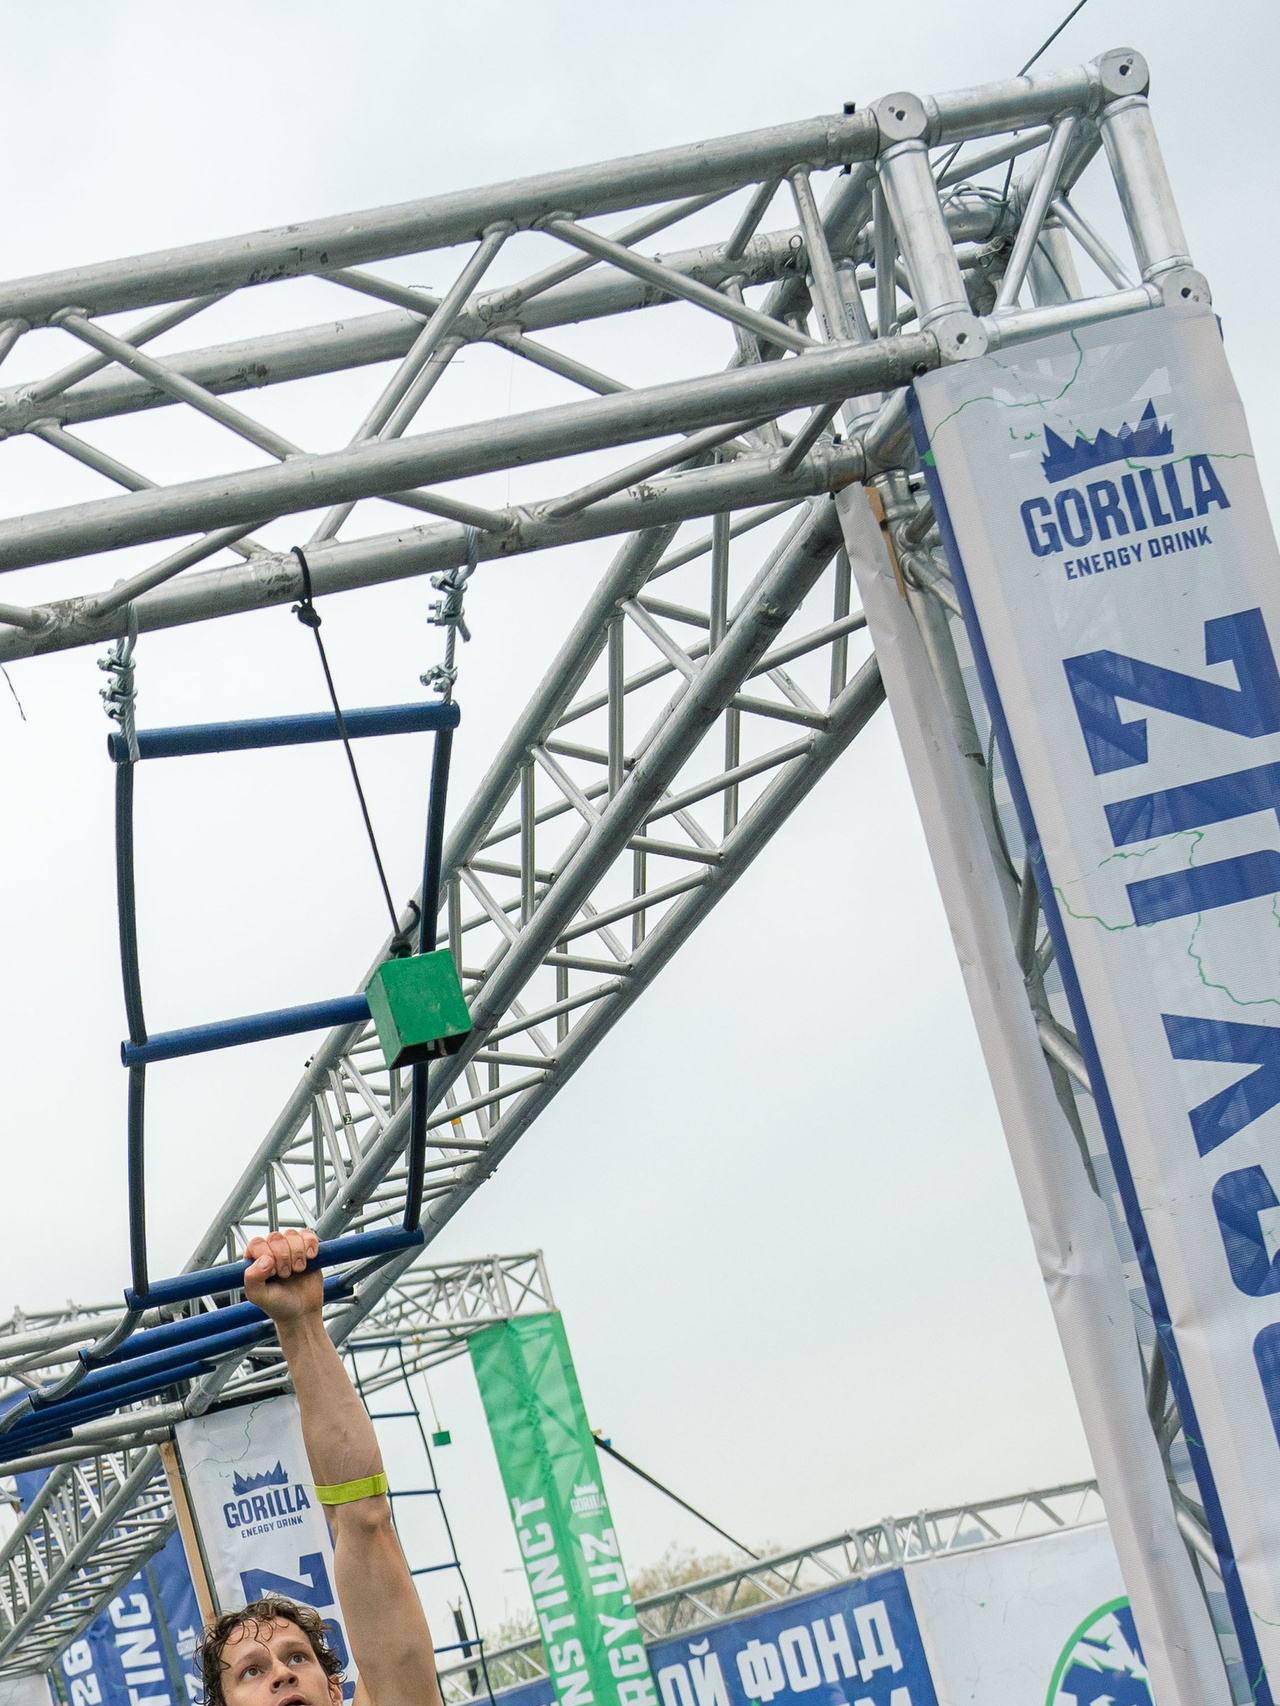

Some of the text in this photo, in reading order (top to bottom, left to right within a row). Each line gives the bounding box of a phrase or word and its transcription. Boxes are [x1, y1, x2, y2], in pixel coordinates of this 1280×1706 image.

[1020, 454, 1231, 558] GORILLA
[1064, 526, 1213, 580] ENERGY DRINK
[222, 1484, 311, 1529] GORILLA
[241, 1515, 304, 1539] ENERGY DRINK
[736, 1600, 904, 1702] ФОНД
